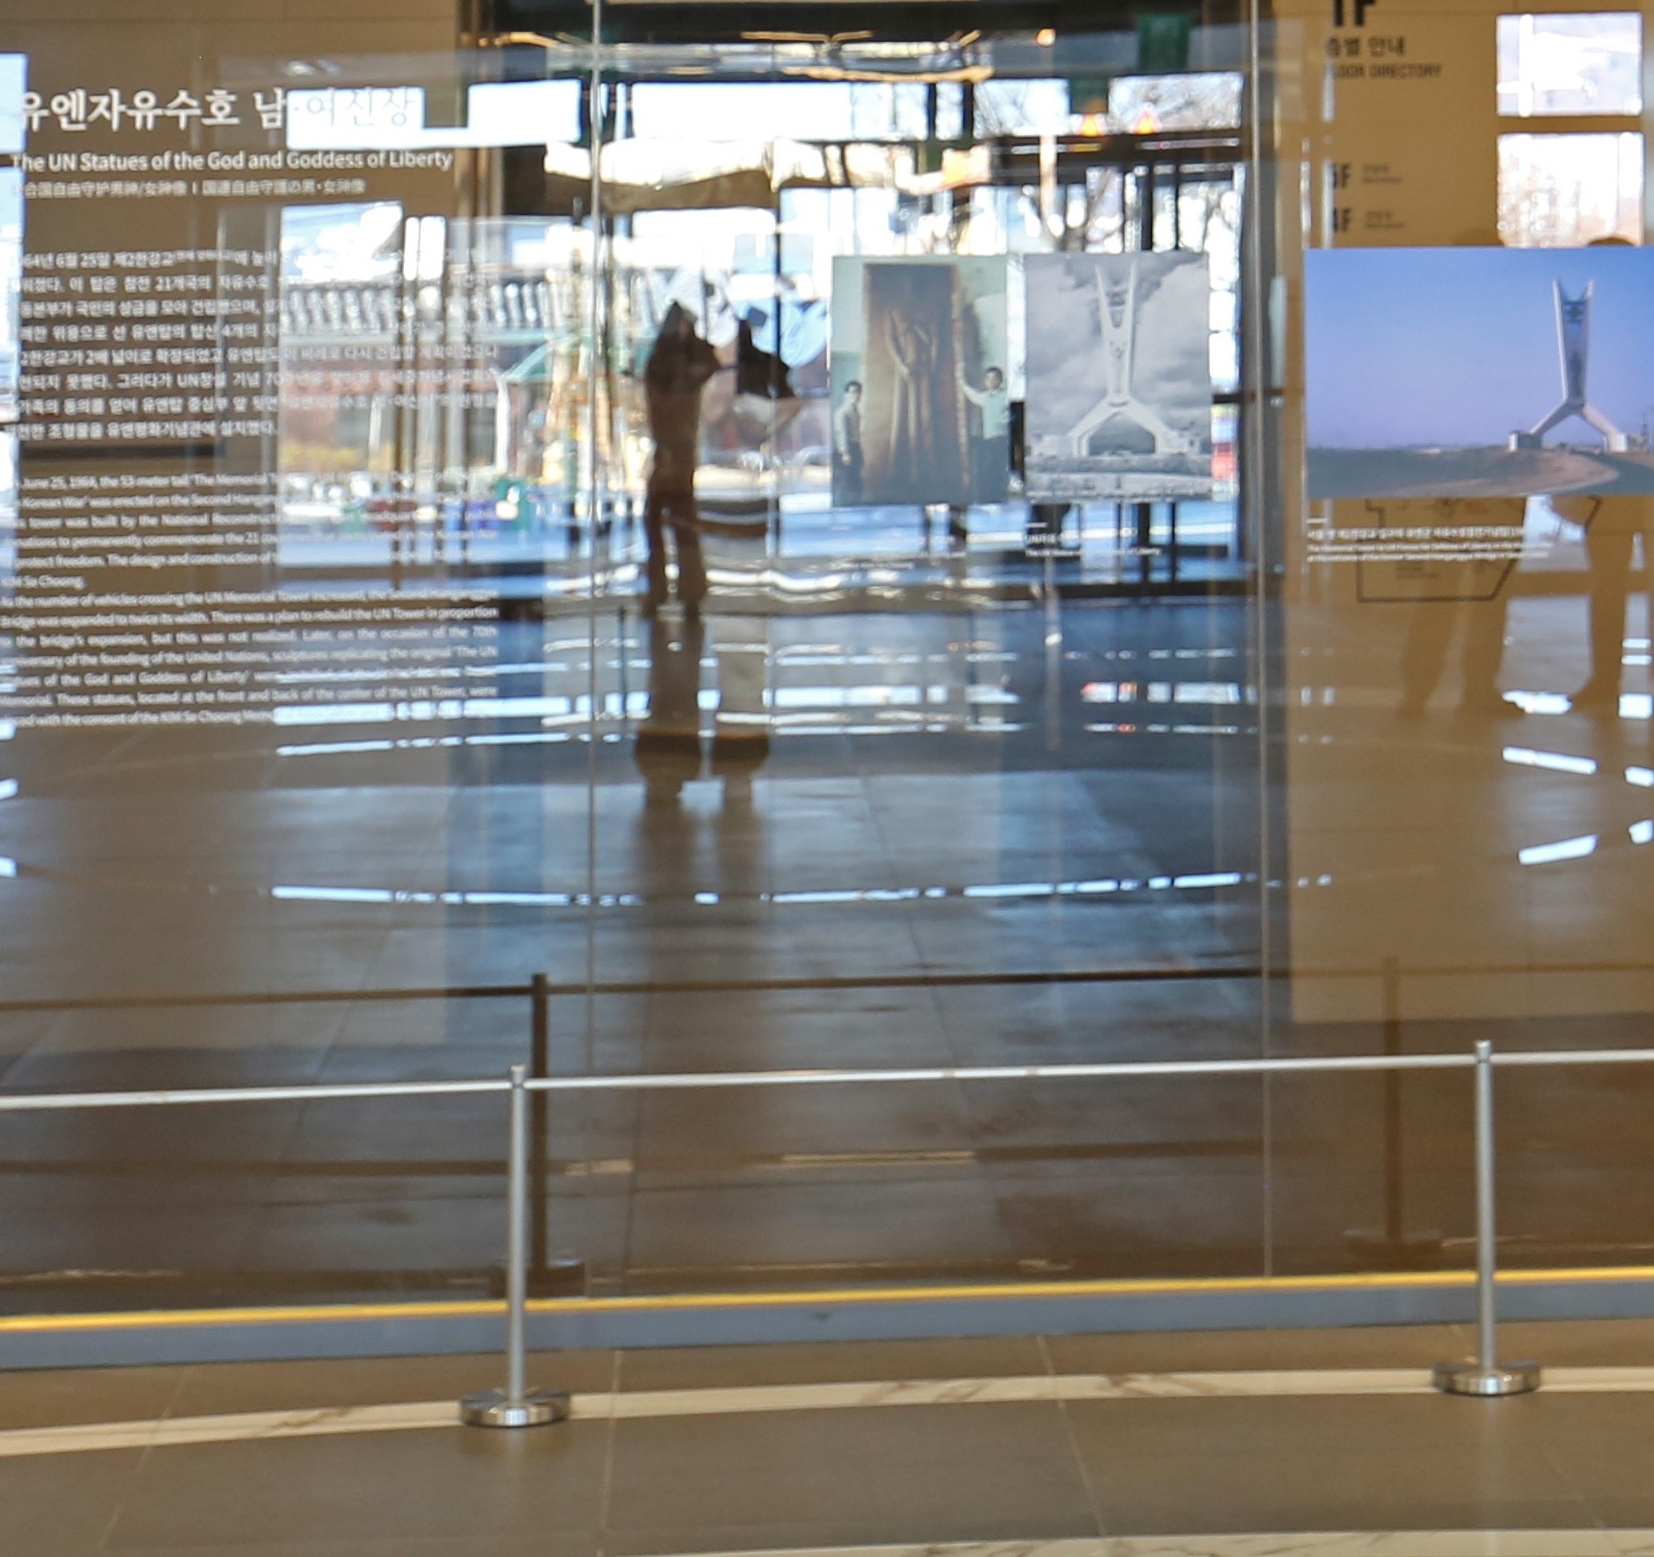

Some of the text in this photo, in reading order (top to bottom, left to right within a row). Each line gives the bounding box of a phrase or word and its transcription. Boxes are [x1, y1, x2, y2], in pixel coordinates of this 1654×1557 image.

[22, 88, 240, 132] 유엔자유수호
[11, 149, 454, 172] The UN Statues of the God and Goddess of Liberty
